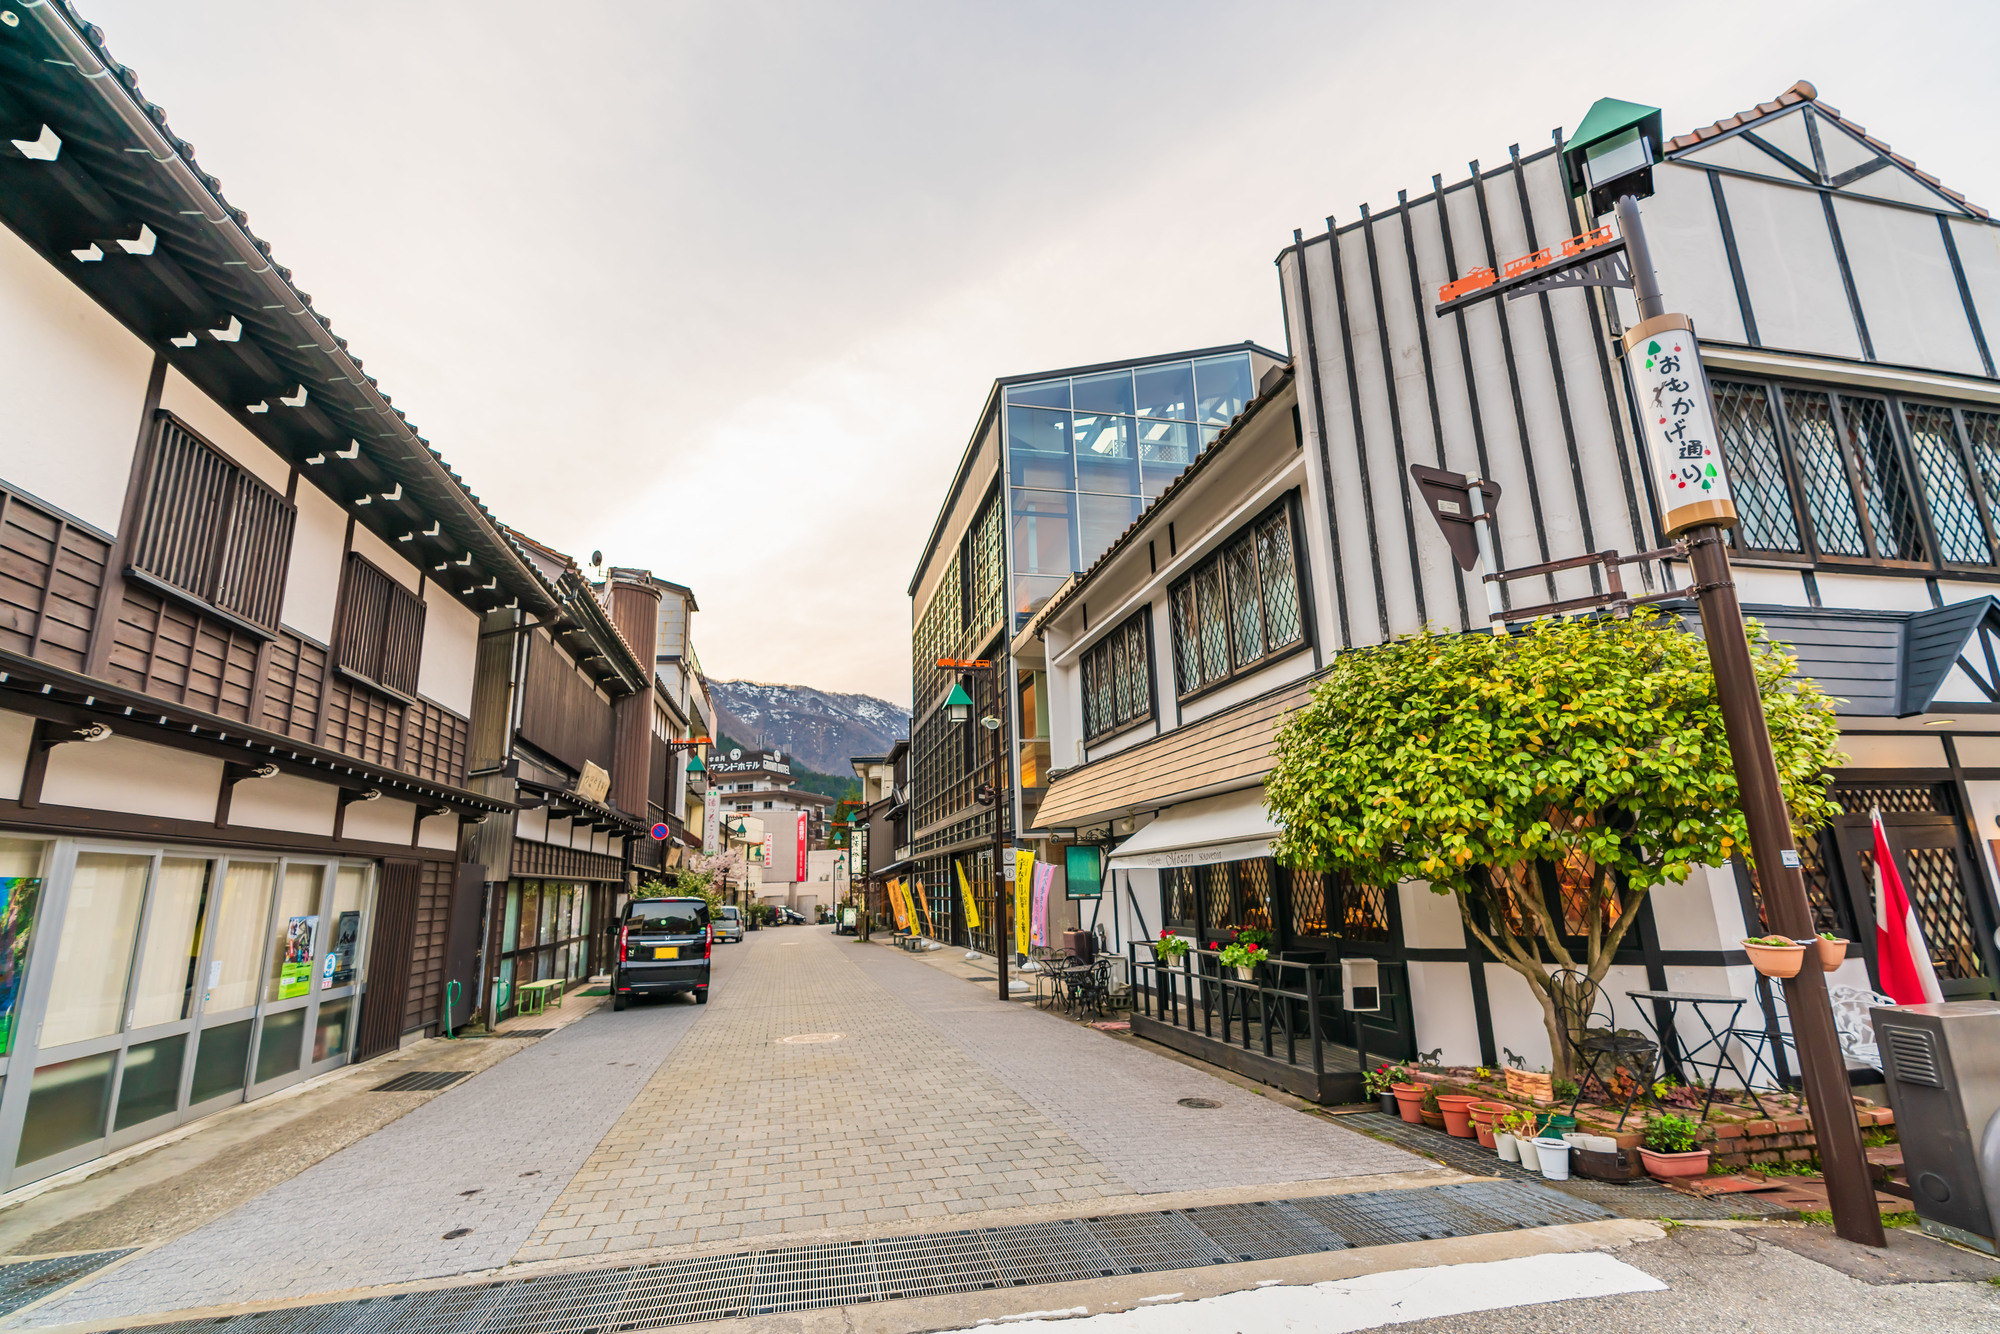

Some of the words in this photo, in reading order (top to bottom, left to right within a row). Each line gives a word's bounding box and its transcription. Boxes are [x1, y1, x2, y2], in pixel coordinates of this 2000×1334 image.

[1659, 355, 1704, 484] おもかげ通り
